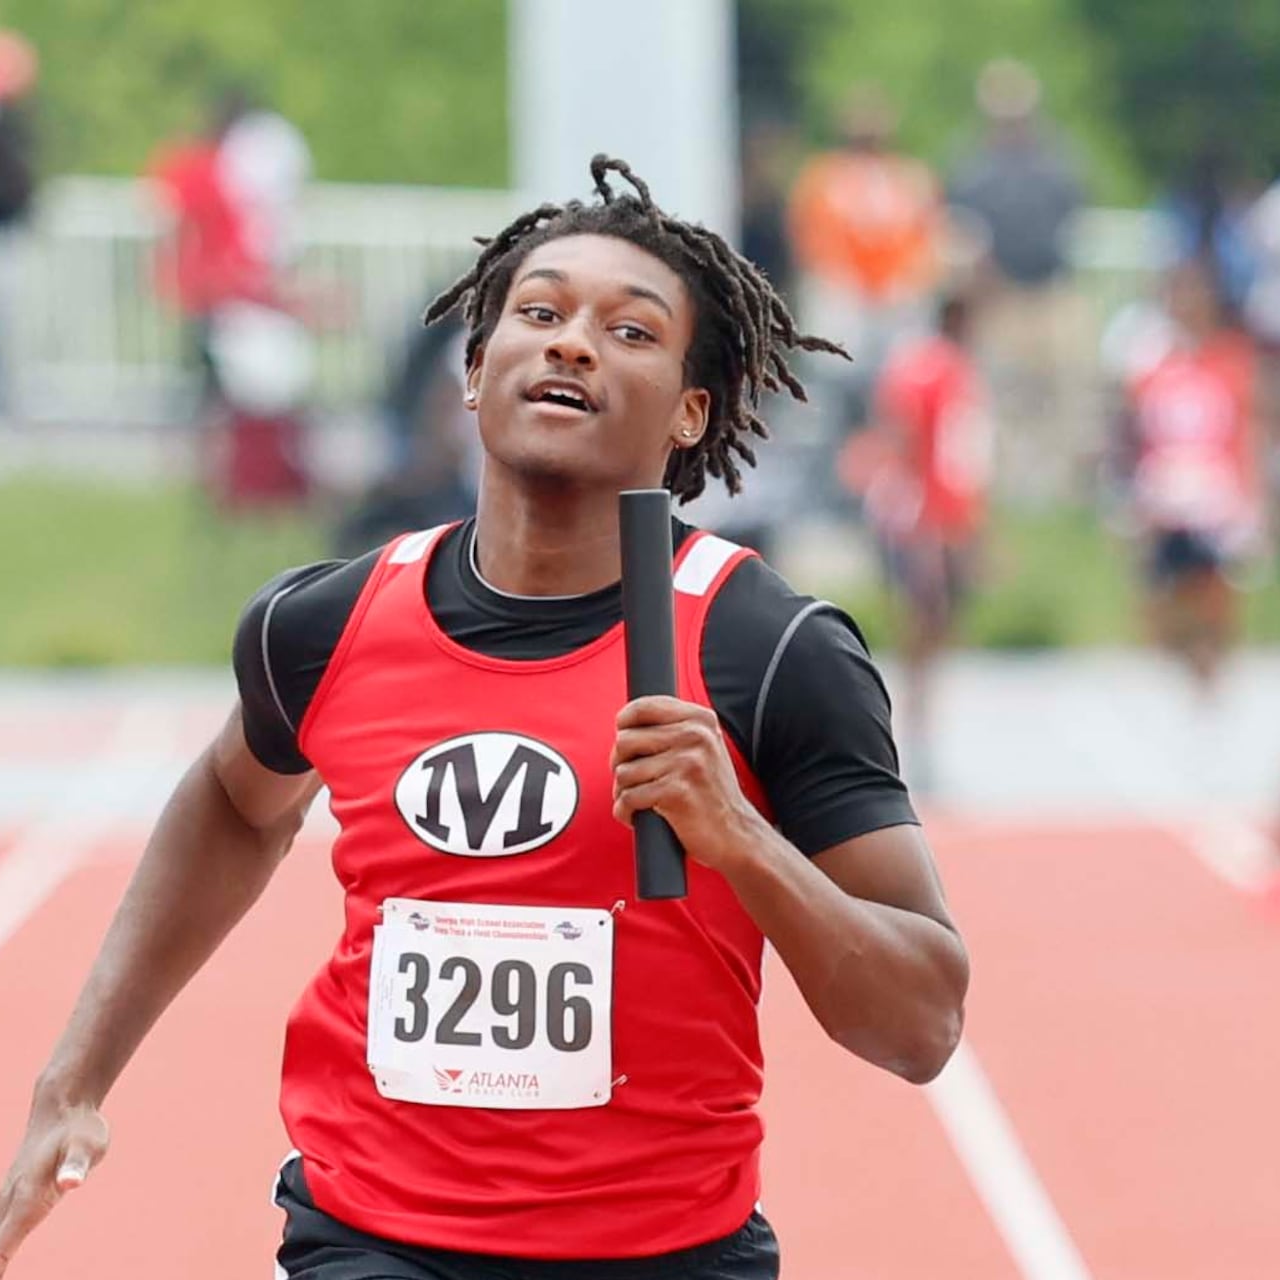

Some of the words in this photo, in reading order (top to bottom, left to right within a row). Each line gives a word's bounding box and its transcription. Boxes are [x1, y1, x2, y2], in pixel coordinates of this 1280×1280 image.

[415, 742, 562, 851] M
[393, 951, 594, 1053] 3296
[468, 1071, 540, 1090] ATLANTA
